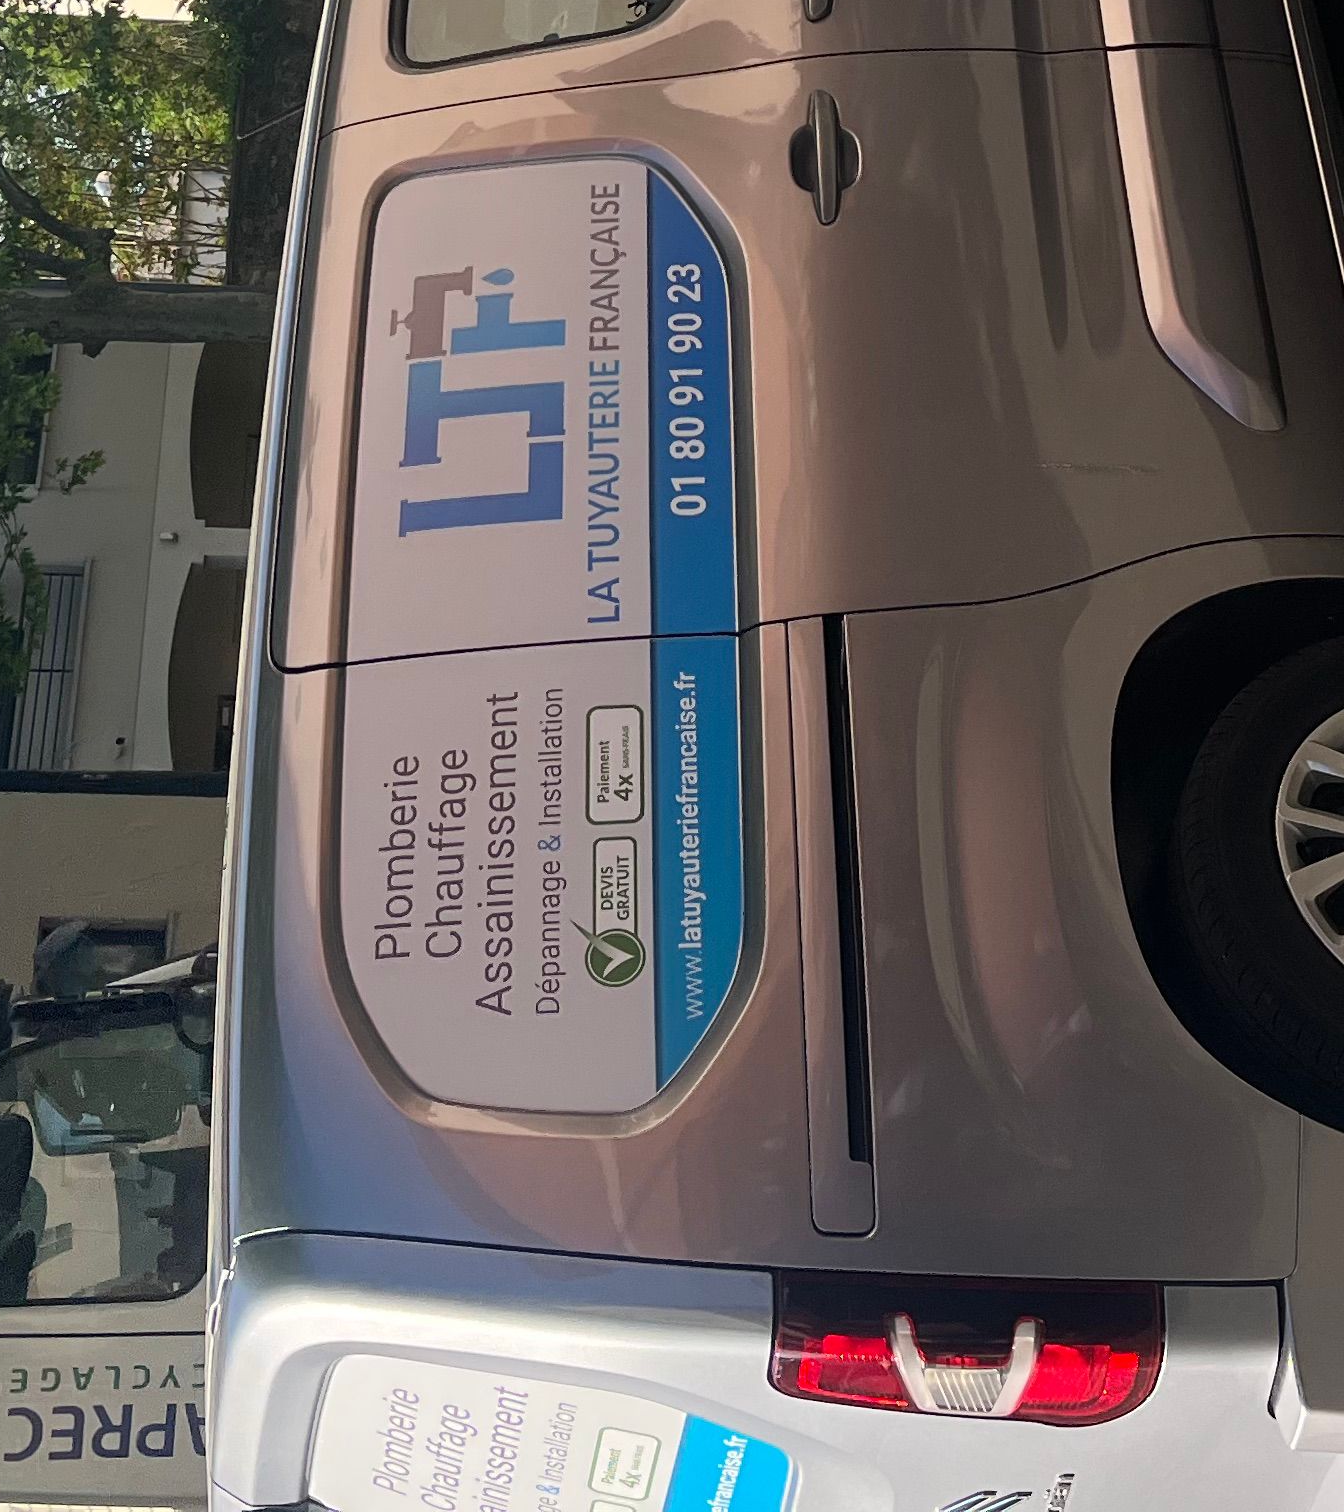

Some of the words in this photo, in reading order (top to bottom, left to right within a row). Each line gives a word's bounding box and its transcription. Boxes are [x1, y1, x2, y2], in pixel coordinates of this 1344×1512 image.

[588, 183, 627, 352] FRANÇAISE
[666, 263, 702, 303] 23
[667, 313, 703, 353] 90
[389, 266, 566, 538] LTF
[668, 367, 704, 406] 91
[587, 360, 621, 572] TUYAUTERIE
[669, 416, 705, 460] 80
[670, 475, 706, 516] 01
[586, 577, 621, 624] LA
[537, 688, 564, 826] Installation
[597, 740, 610, 803] Paiement
[613, 773, 634, 802] 4x
[374, 755, 420, 960] Plomberie
[425, 748, 476, 959] Chauffage
[475, 691, 519, 1016] Assainissement
[537, 835, 560, 852] &
[674, 672, 708, 1020] www.latuyauteriefrancaise.fr
[600, 866, 615, 911] DEVIS
[615, 855, 631, 921] GRATUIT
[535, 860, 567, 1015] Dépannage
[372, 1388, 419, 1496] Plomberie
[420, 1405, 478, 1511] Chauffage
[538, 1402, 577, 1482] Installation
[536, 1484, 560, 1495] &
